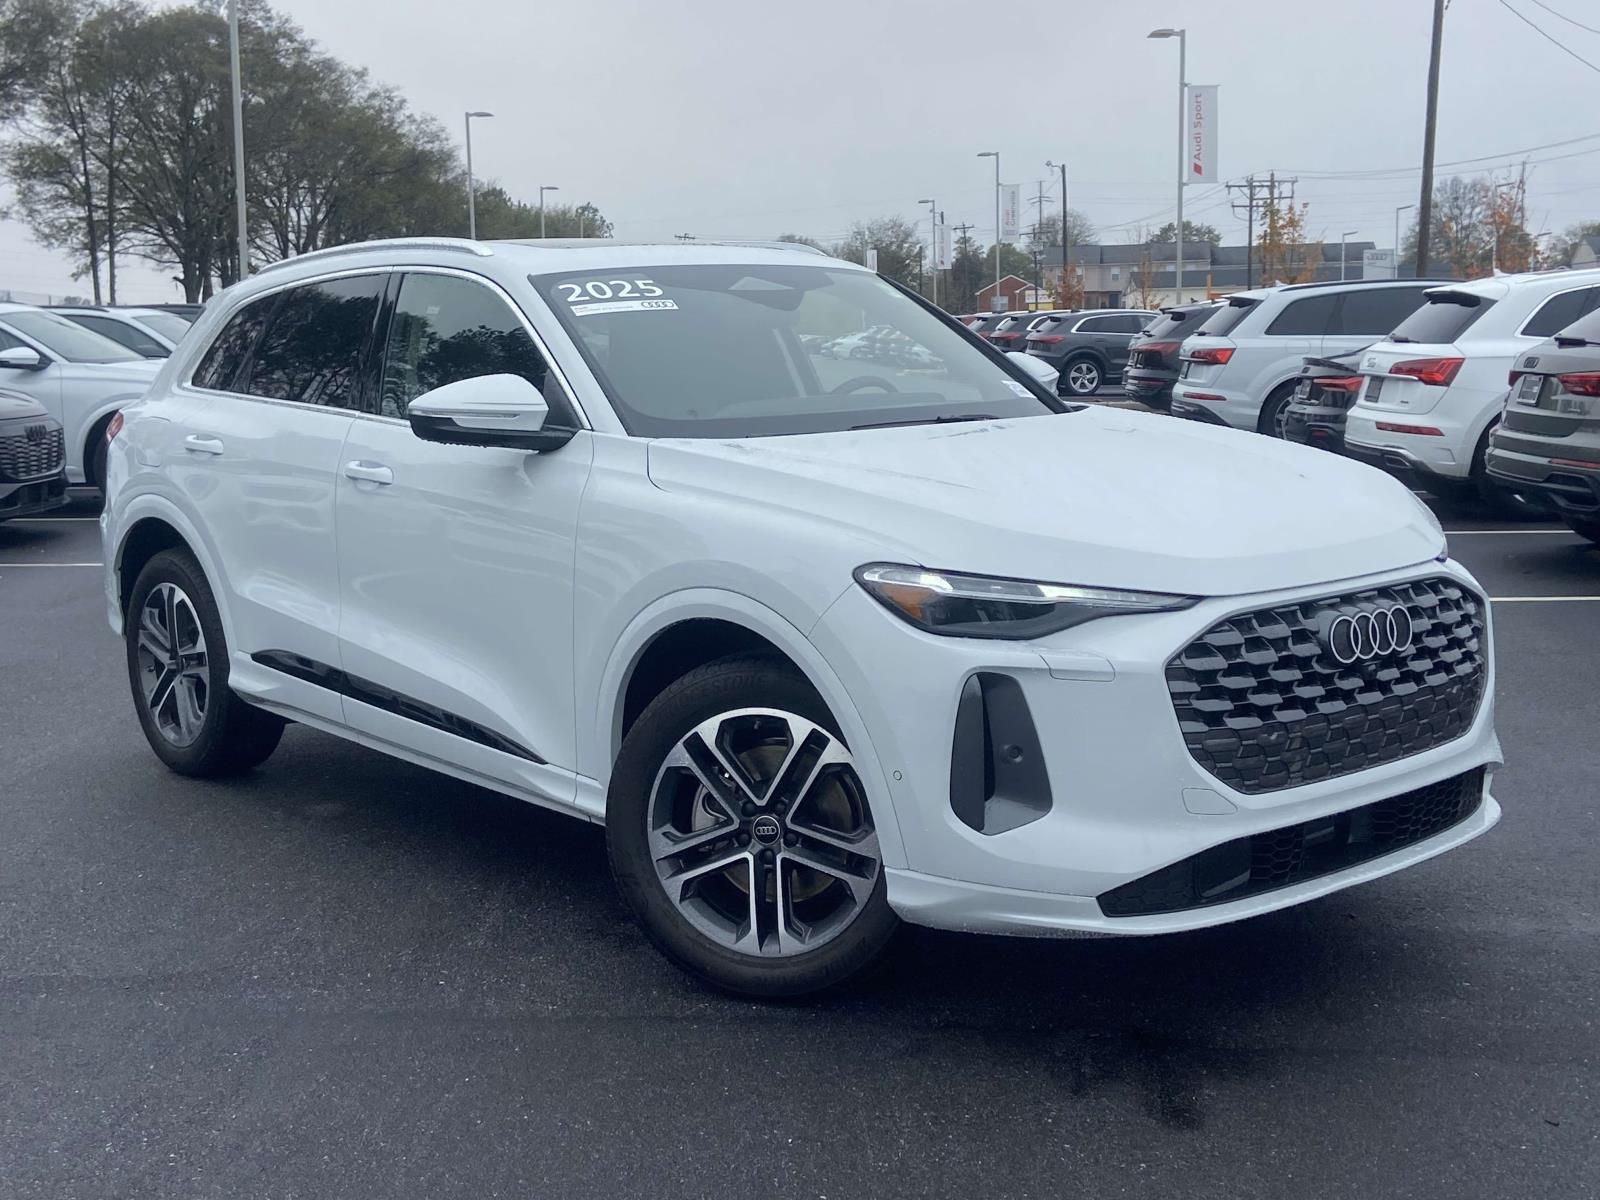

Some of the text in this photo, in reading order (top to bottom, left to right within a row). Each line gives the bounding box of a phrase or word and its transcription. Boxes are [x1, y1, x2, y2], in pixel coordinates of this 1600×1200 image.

[1193, 93, 1204, 161] Audi Sport
[557, 279, 664, 302] 2025
